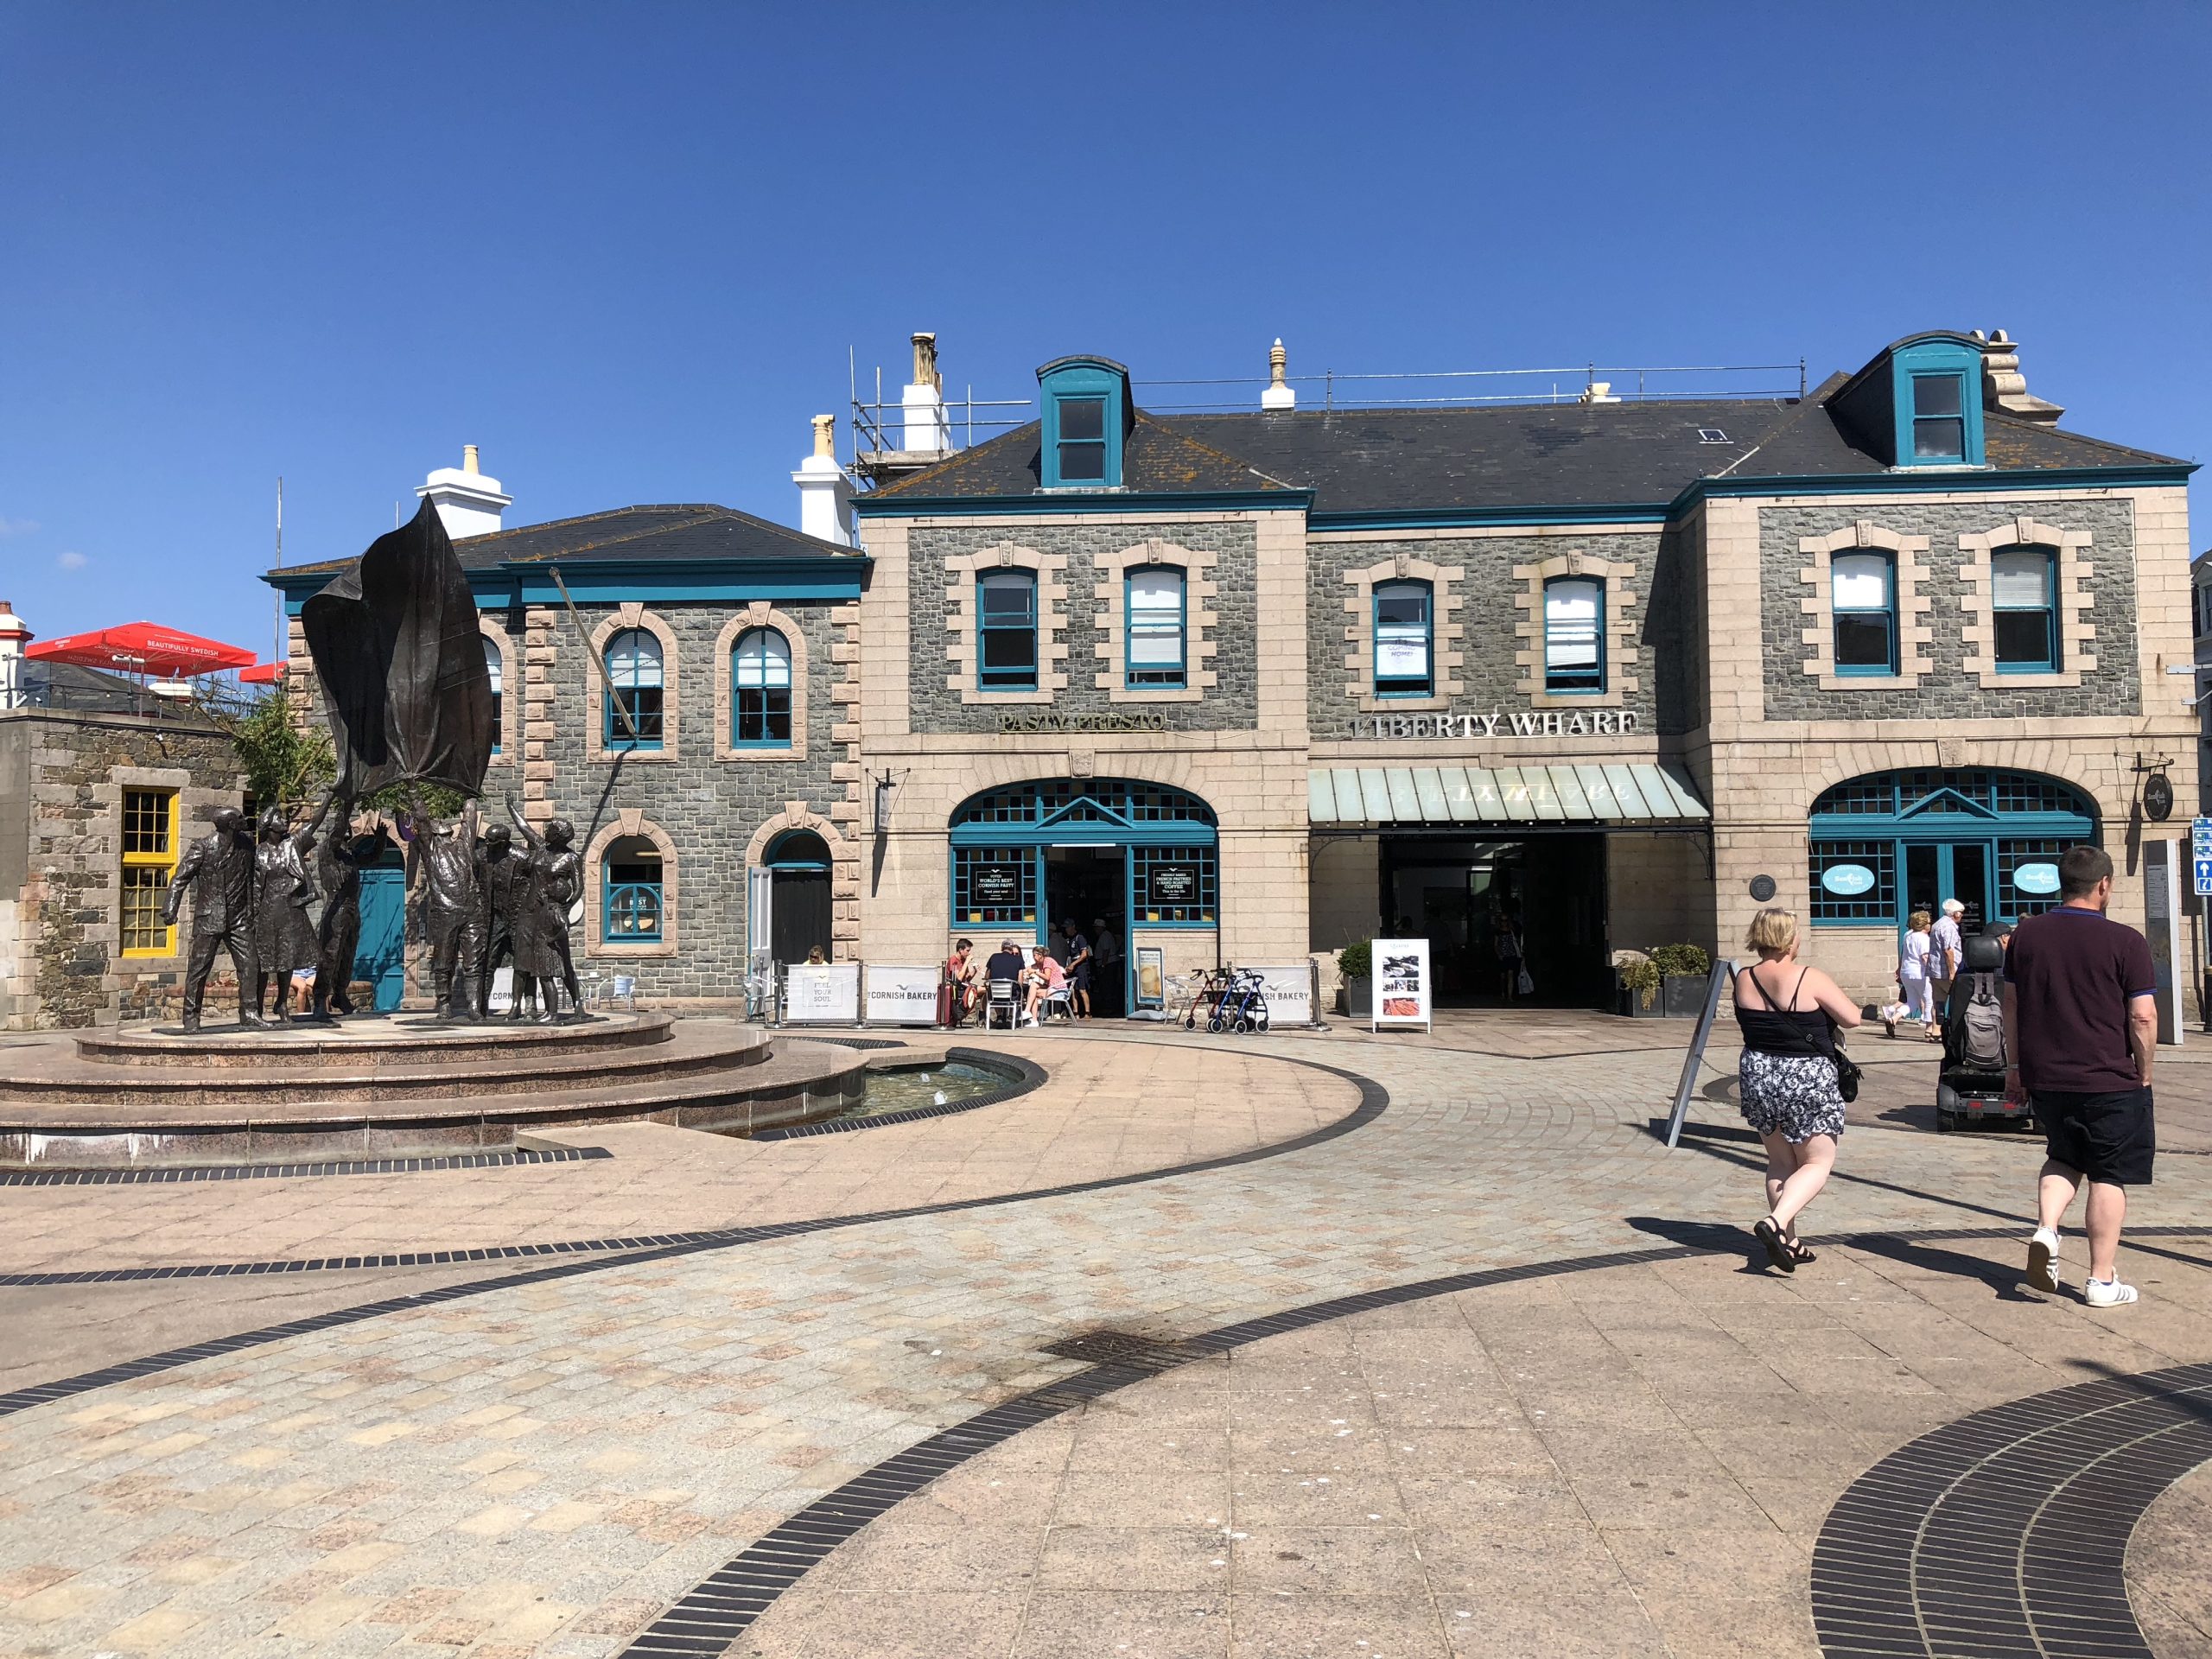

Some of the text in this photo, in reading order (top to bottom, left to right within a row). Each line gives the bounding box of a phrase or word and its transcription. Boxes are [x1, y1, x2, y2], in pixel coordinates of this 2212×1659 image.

[147, 640, 219, 657] BEAUTIFULLY SWEDISH
[1000, 713, 1165, 730] PASTY PRESTO
[1345, 711, 1637, 739] LIBERTY WHARF
[871, 991, 905, 1000] CORNISH
[907, 992, 937, 1001] BAKERY
